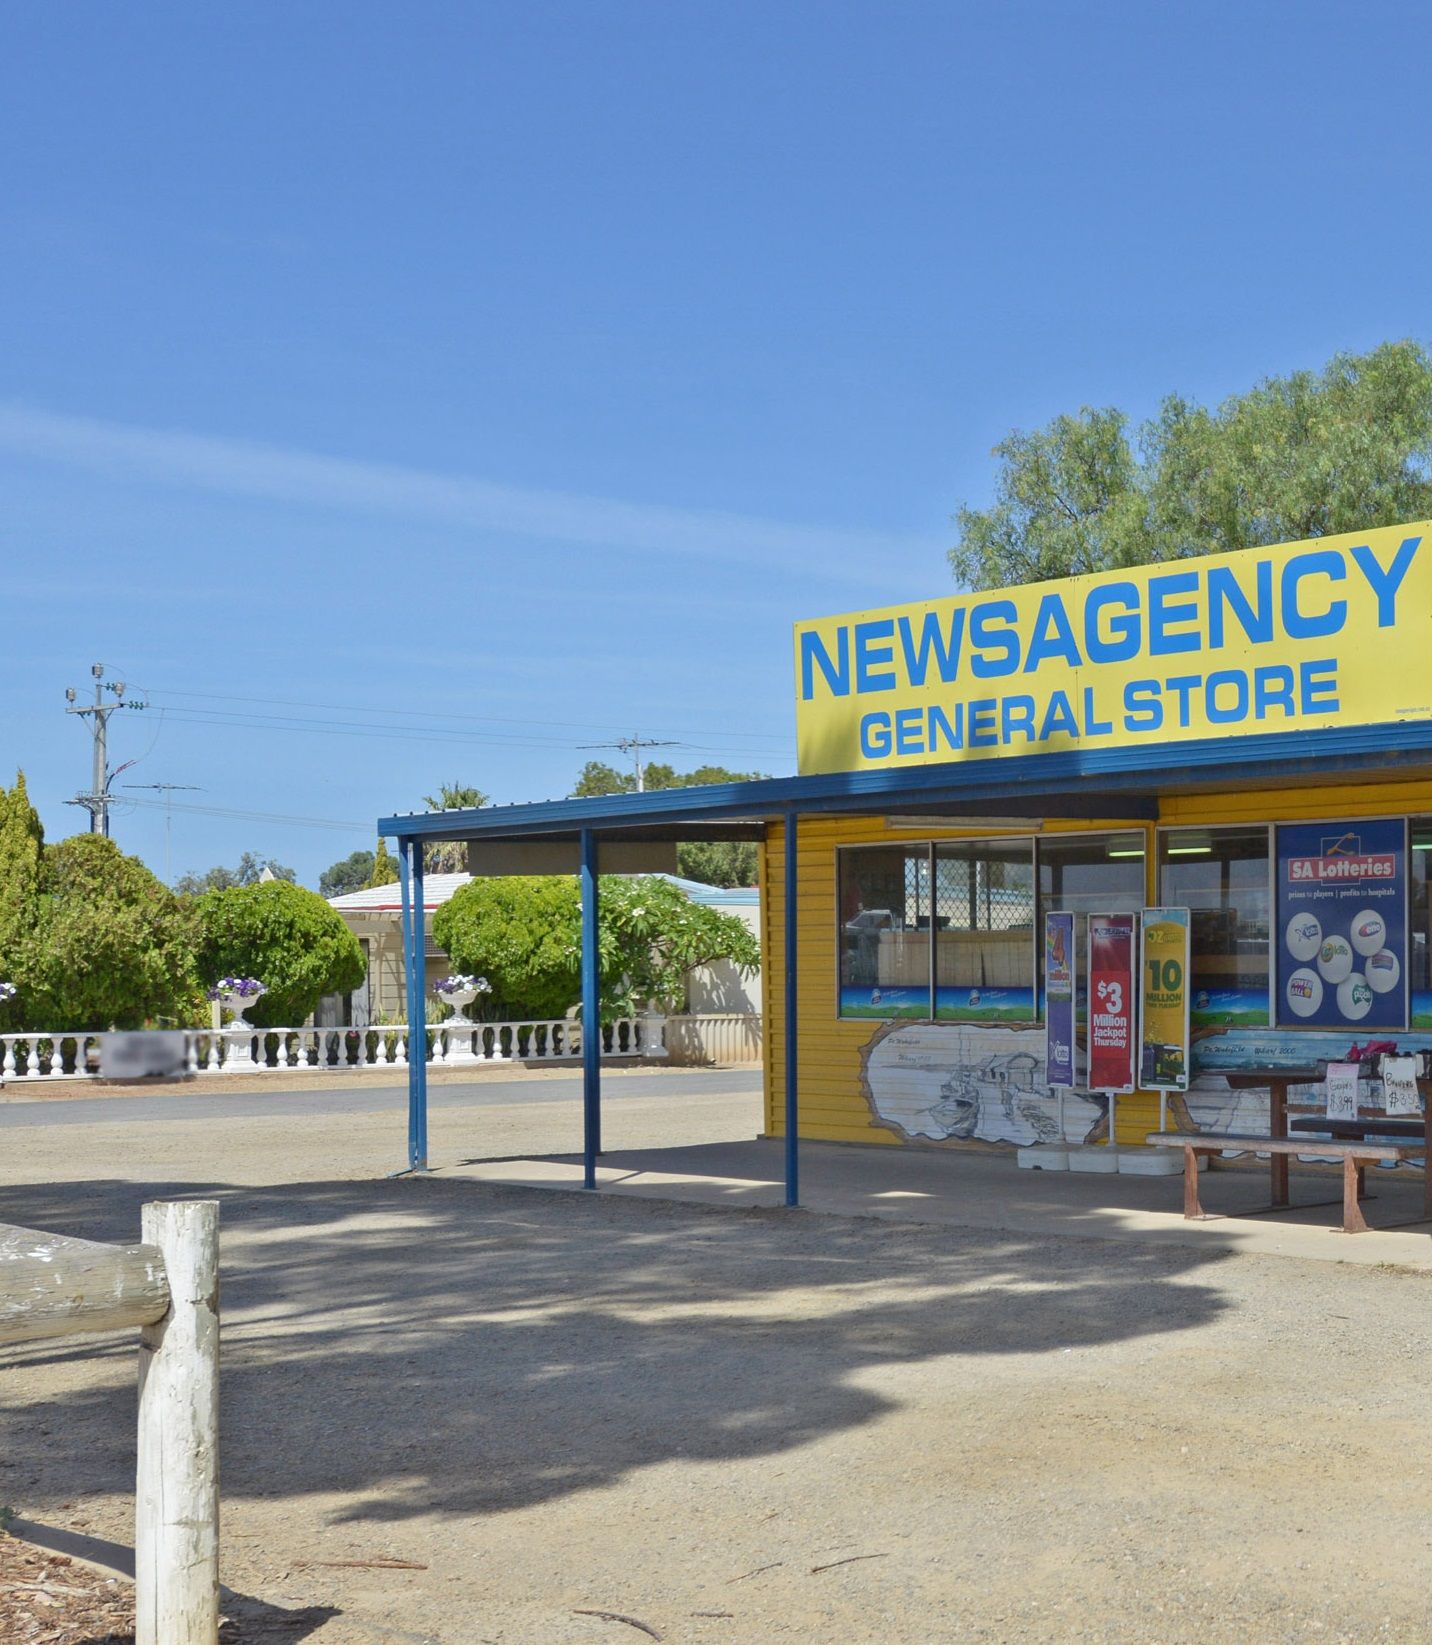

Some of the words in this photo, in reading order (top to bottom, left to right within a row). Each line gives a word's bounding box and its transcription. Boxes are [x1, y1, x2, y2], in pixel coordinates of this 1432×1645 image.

[800, 536, 1422, 701] NEWSAGENCY
[860, 686, 1112, 760] GENERAL
[1124, 658, 1340, 732] STORE
[1292, 861, 1314, 879] SA
[1318, 857, 1392, 877] Lotteries
[1313, 889, 1334, 900] players
[1368, 888, 1395, 898] hospitals
[1097, 980, 1122, 1014] $3
[1146, 992, 1182, 1002] MILLION
[1093, 1014, 1127, 1026] Million
[1093, 1027, 1127, 1040] Jackpot
[1094, 1037, 1127, 1049] Thursday
